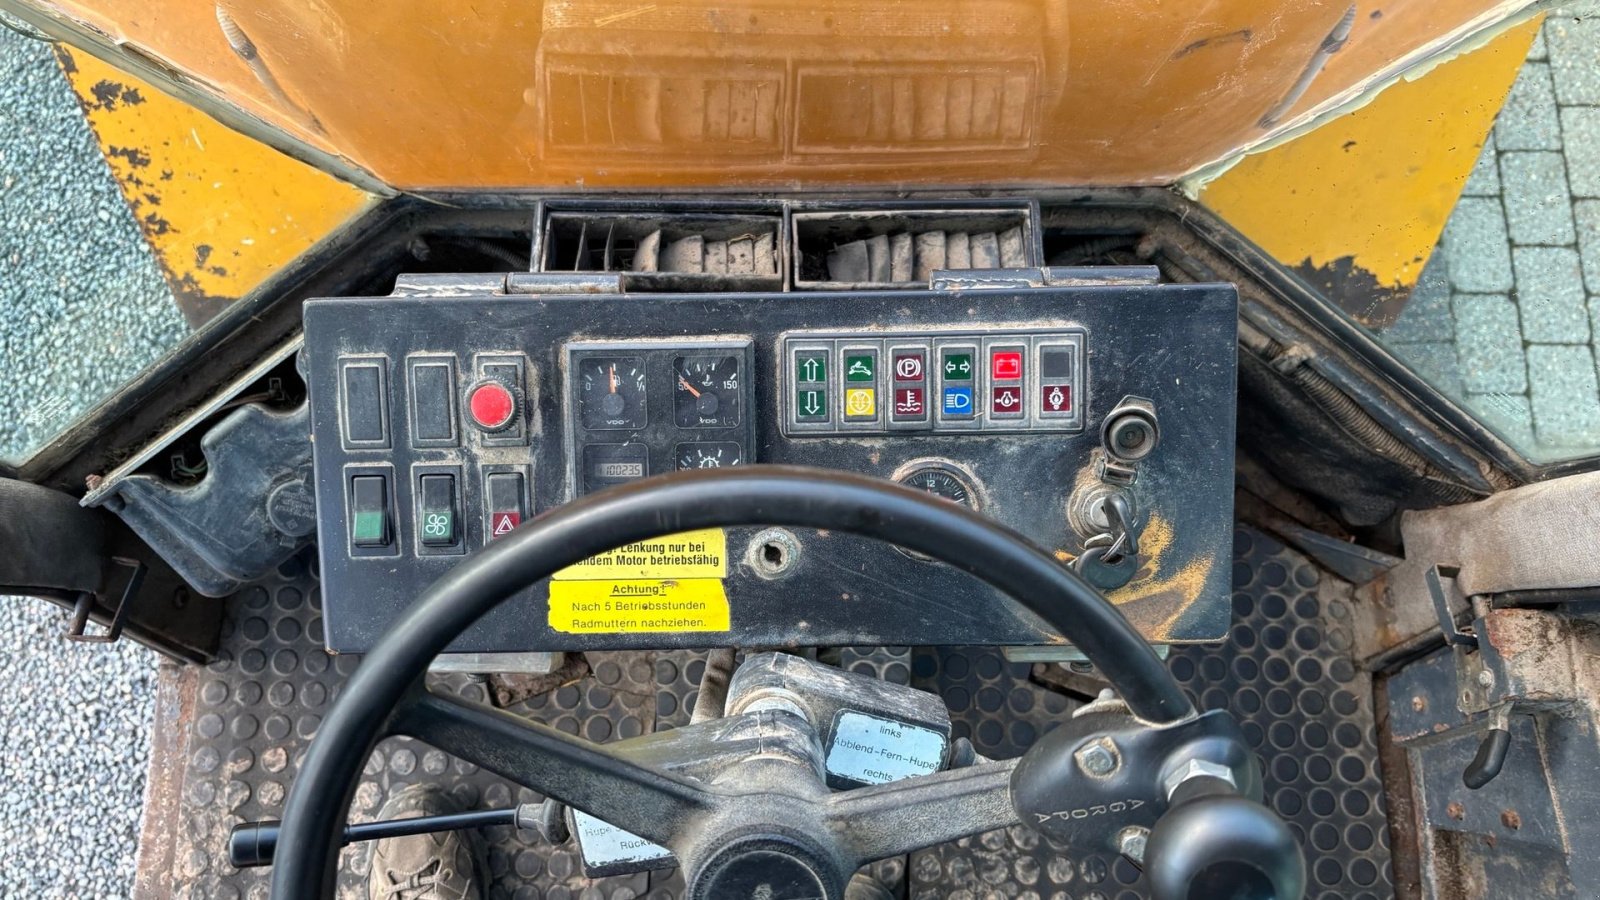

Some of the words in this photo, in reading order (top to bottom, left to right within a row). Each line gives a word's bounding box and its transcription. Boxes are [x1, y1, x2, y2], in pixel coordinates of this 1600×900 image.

[904, 361, 915, 375] P
[723, 380, 738, 389] 150
[926, 479, 936, 488] 12
[620, 542, 665, 554] Lenkung
[668, 544, 686, 553] nur
[689, 541, 706, 553] bei
[573, 555, 613, 566] endem
[616, 555, 647, 566] Motor
[650, 554, 720, 567] betriebsfähig
[612, 584, 665, 596] Achtung!
[572, 601, 601, 611] Nach
[604, 601, 612, 611] 5
[615, 600, 706, 611] Betriebsstunden
[572, 619, 637, 629] Radmuttern
[641, 618, 707, 628] nachziehen.
[879, 725, 902, 739] links
[863, 767, 894, 782] rechts
[1034, 798, 1145, 823] AGROPA
[619, 838, 656, 850] Rückw
